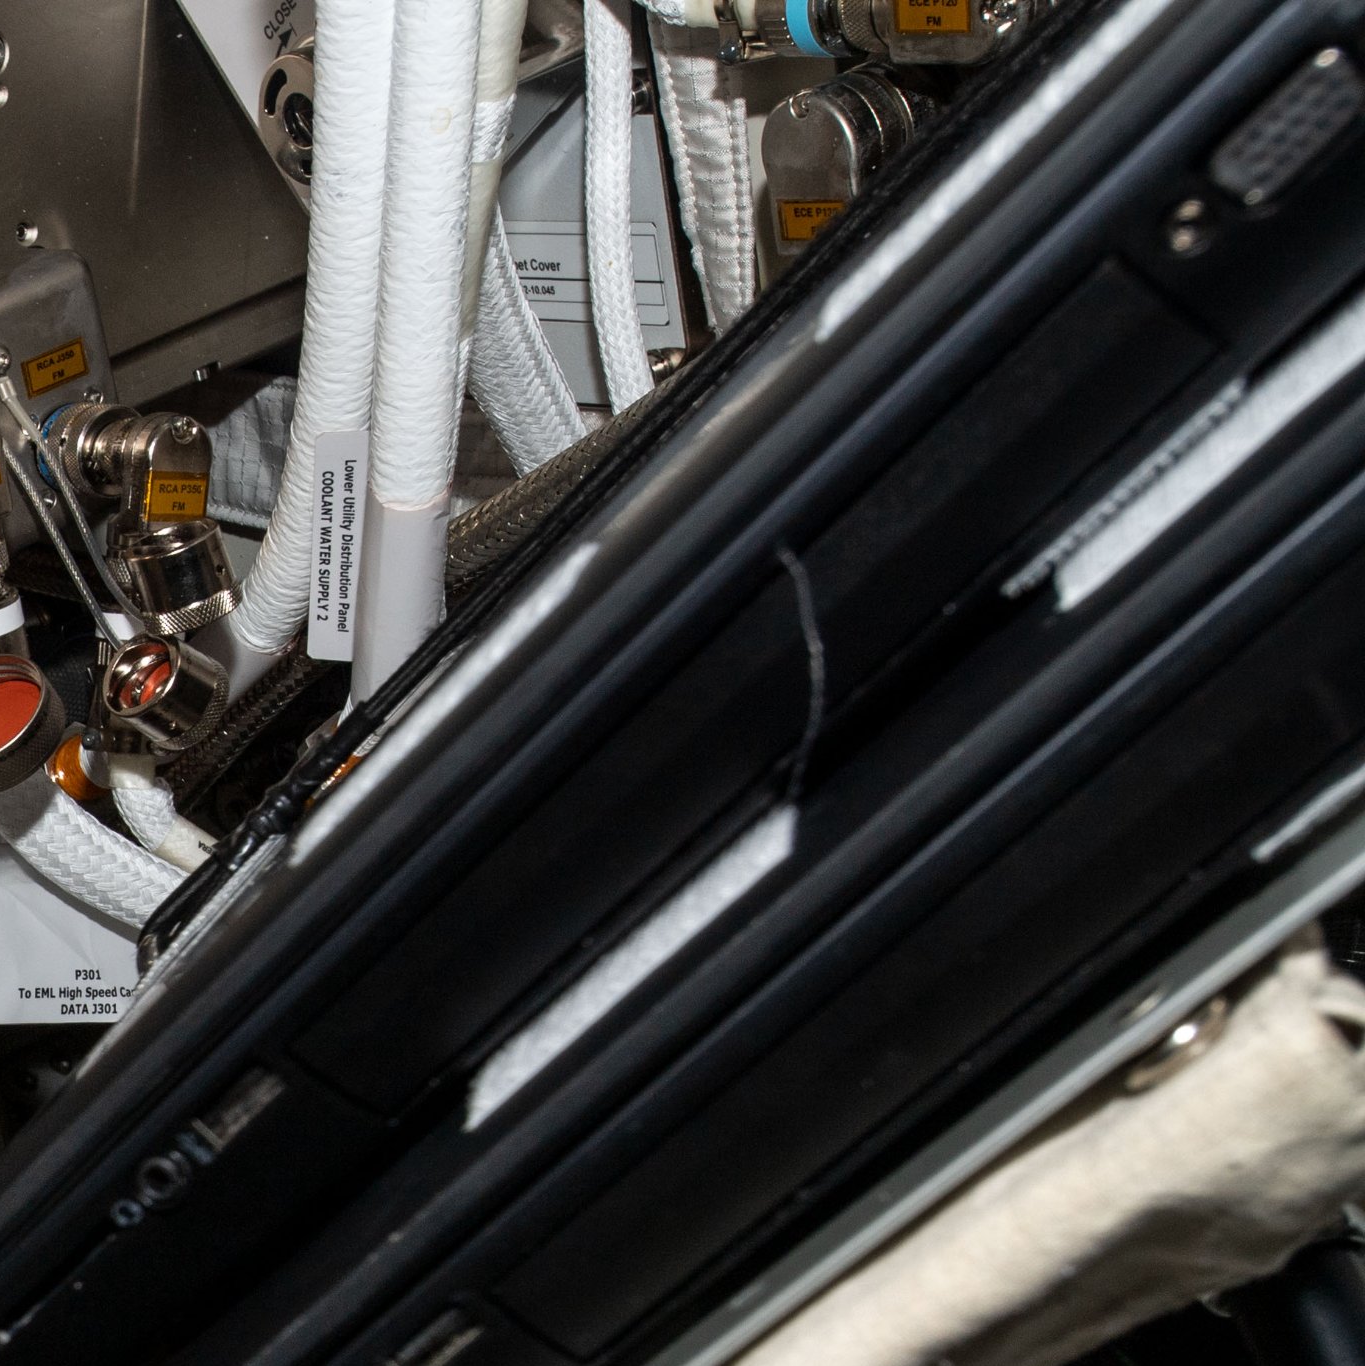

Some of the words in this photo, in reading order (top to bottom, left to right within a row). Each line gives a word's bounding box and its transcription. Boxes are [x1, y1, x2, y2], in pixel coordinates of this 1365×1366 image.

[264, 0, 297, 39] CLOSE
[926, 16, 941, 27] FM
[530, 259, 561, 272] Cover
[159, 483, 179, 494] RCA
[344, 460, 357, 494] Lower
[171, 501, 186, 511] FM
[321, 470, 335, 523] COOLANT
[339, 497, 355, 531] Utility
[319, 526, 333, 566] WATER
[339, 534, 354, 600] Distribution
[317, 568, 331, 612] SUPPLY
[317, 614, 329, 622] 2
[338, 602, 350, 633] Panel
[74, 969, 102, 981] P301
[18, 988, 32, 999] To
[34, 987, 56, 998] EML
[59, 986, 82, 1001] High
[85, 986, 117, 1000] Speed
[120, 986, 134, 998] Ca
[60, 1003, 89, 1015] DATA
[92, 1002, 118, 1014] J301
